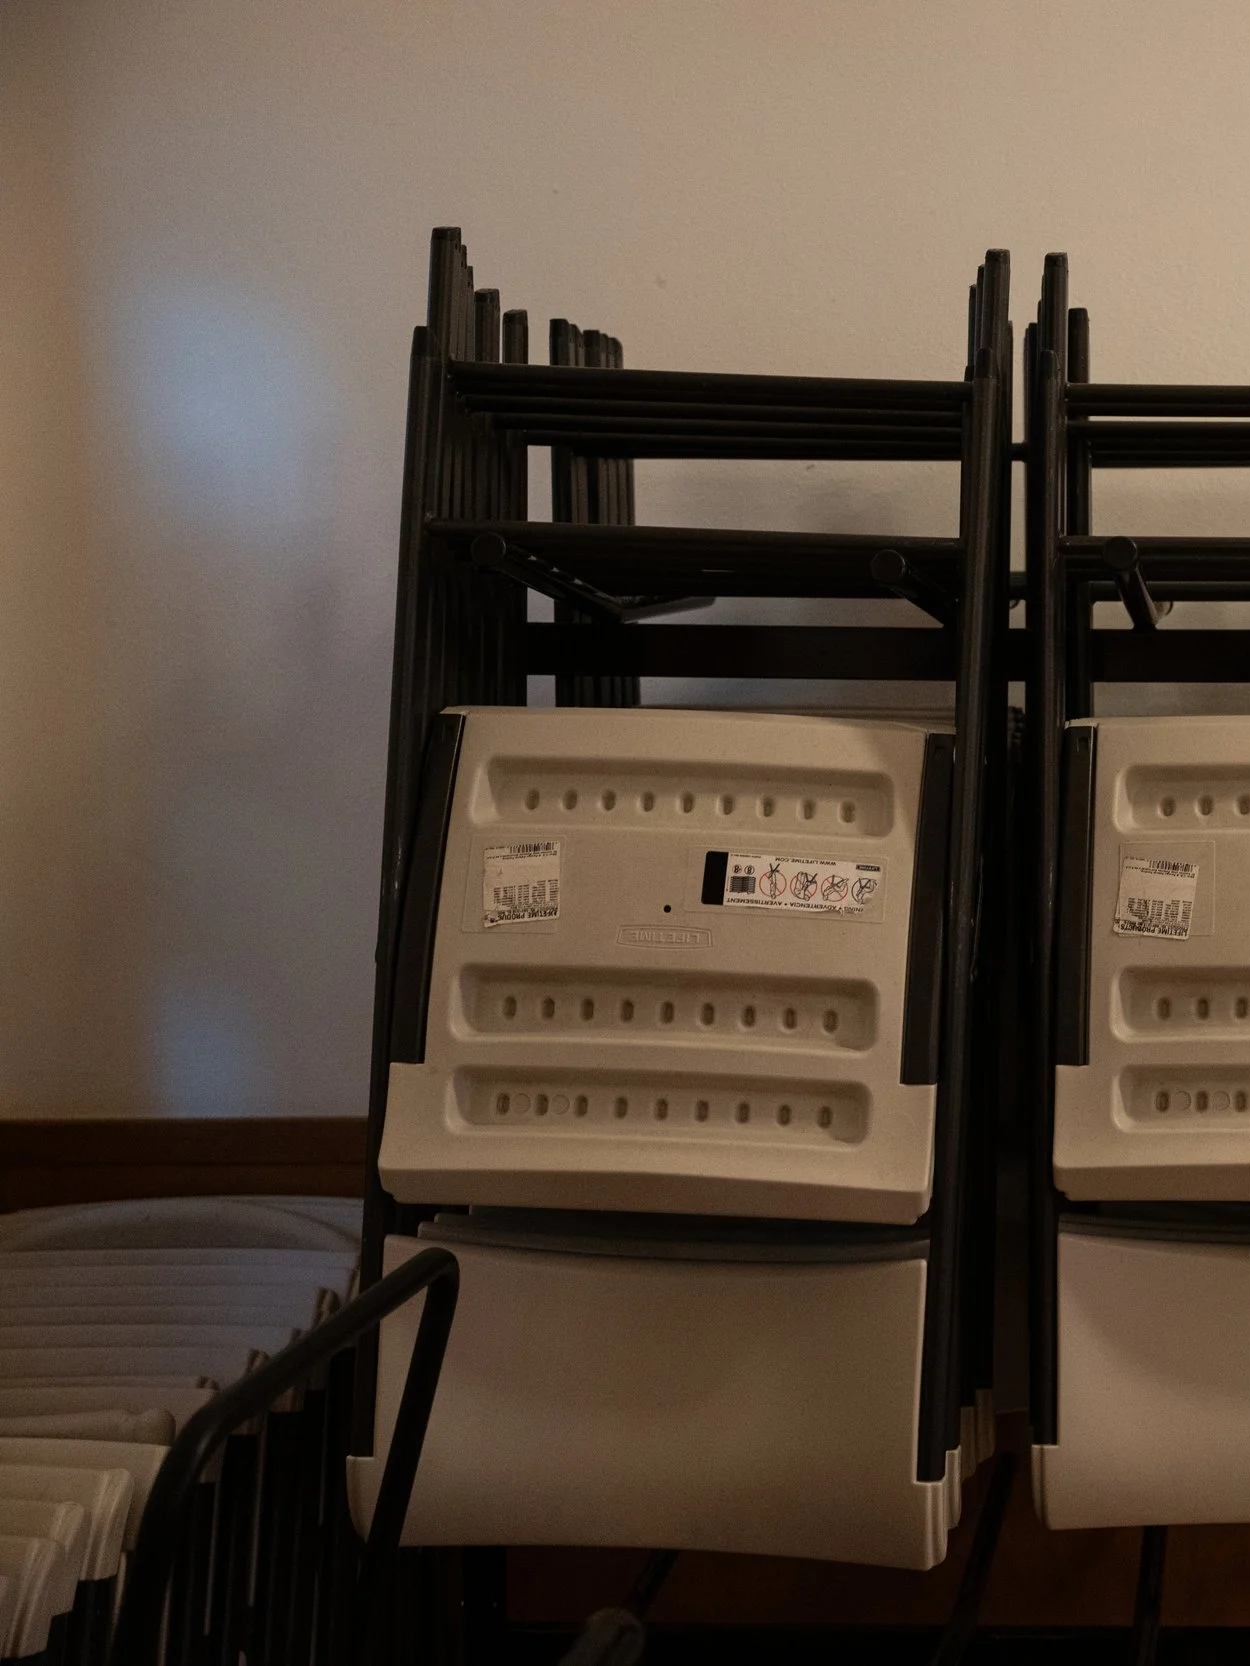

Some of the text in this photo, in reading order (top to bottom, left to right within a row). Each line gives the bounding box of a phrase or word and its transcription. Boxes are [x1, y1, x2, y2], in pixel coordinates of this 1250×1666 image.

[775, 857, 837, 866] WWW.LIFETIME.COM
[726, 897, 783, 906] AVERTISSEMENT
[790, 902, 837, 911] ADVERTENCIA
[1120, 923, 1188, 937] LIFETIME PRODUCTS
[630, 930, 701, 944] LIFETIME
